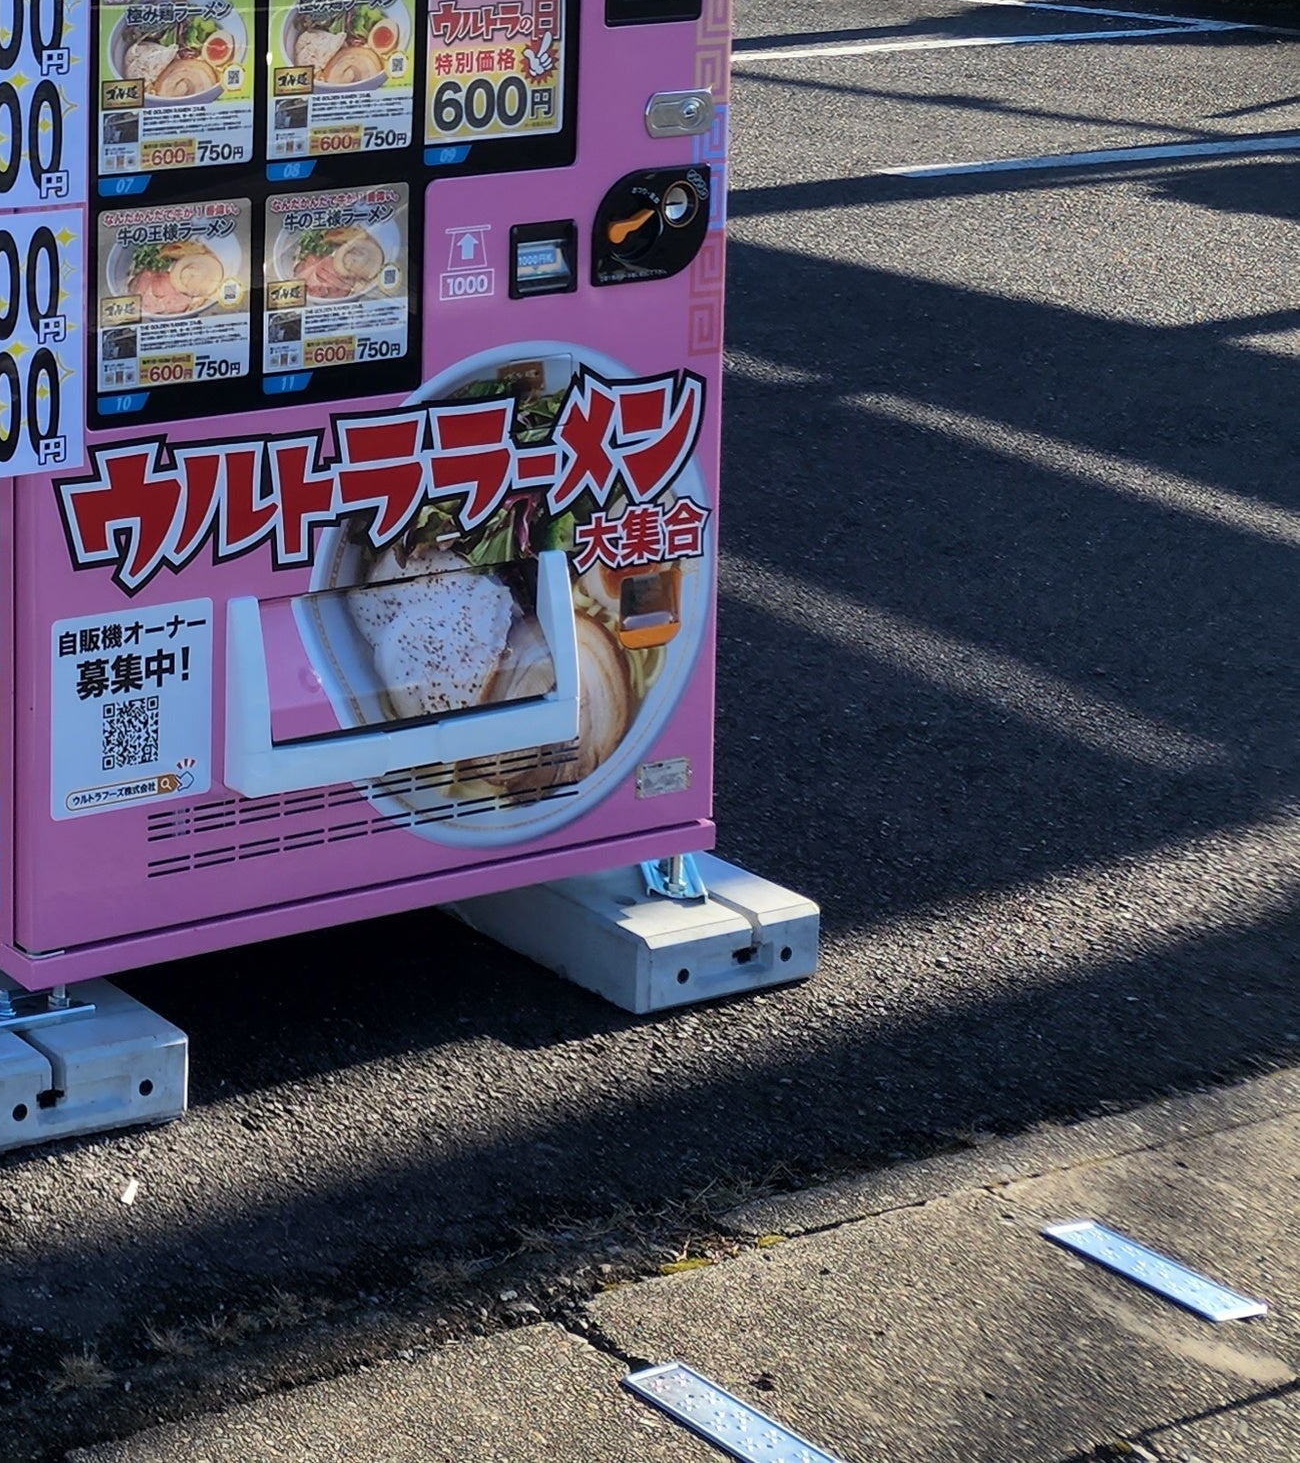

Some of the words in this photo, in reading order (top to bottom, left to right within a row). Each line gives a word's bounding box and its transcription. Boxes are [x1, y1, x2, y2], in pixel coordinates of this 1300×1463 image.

[127, 1, 233, 25] 極み鶏ラーメン
[435, 48, 516, 75] 特別価格
[433, 75, 556, 133] 600円
[364, 130, 407, 148] 750円
[197, 143, 244, 162] 750円
[284, 205, 395, 231] 牛の王様ラーメン
[117, 219, 236, 246] 牛の王様ラーメン
[446, 275, 488, 296] 1000
[357, 341, 400, 360] 750円
[195, 360, 241, 378] 750円
[53, 363, 706, 598] ウルトララーメン
[574, 498, 710, 573] 大集合
[59, 614, 207, 657] 自販機オーナー
[72, 782, 156, 806] ウルトラフーズ株式会社
